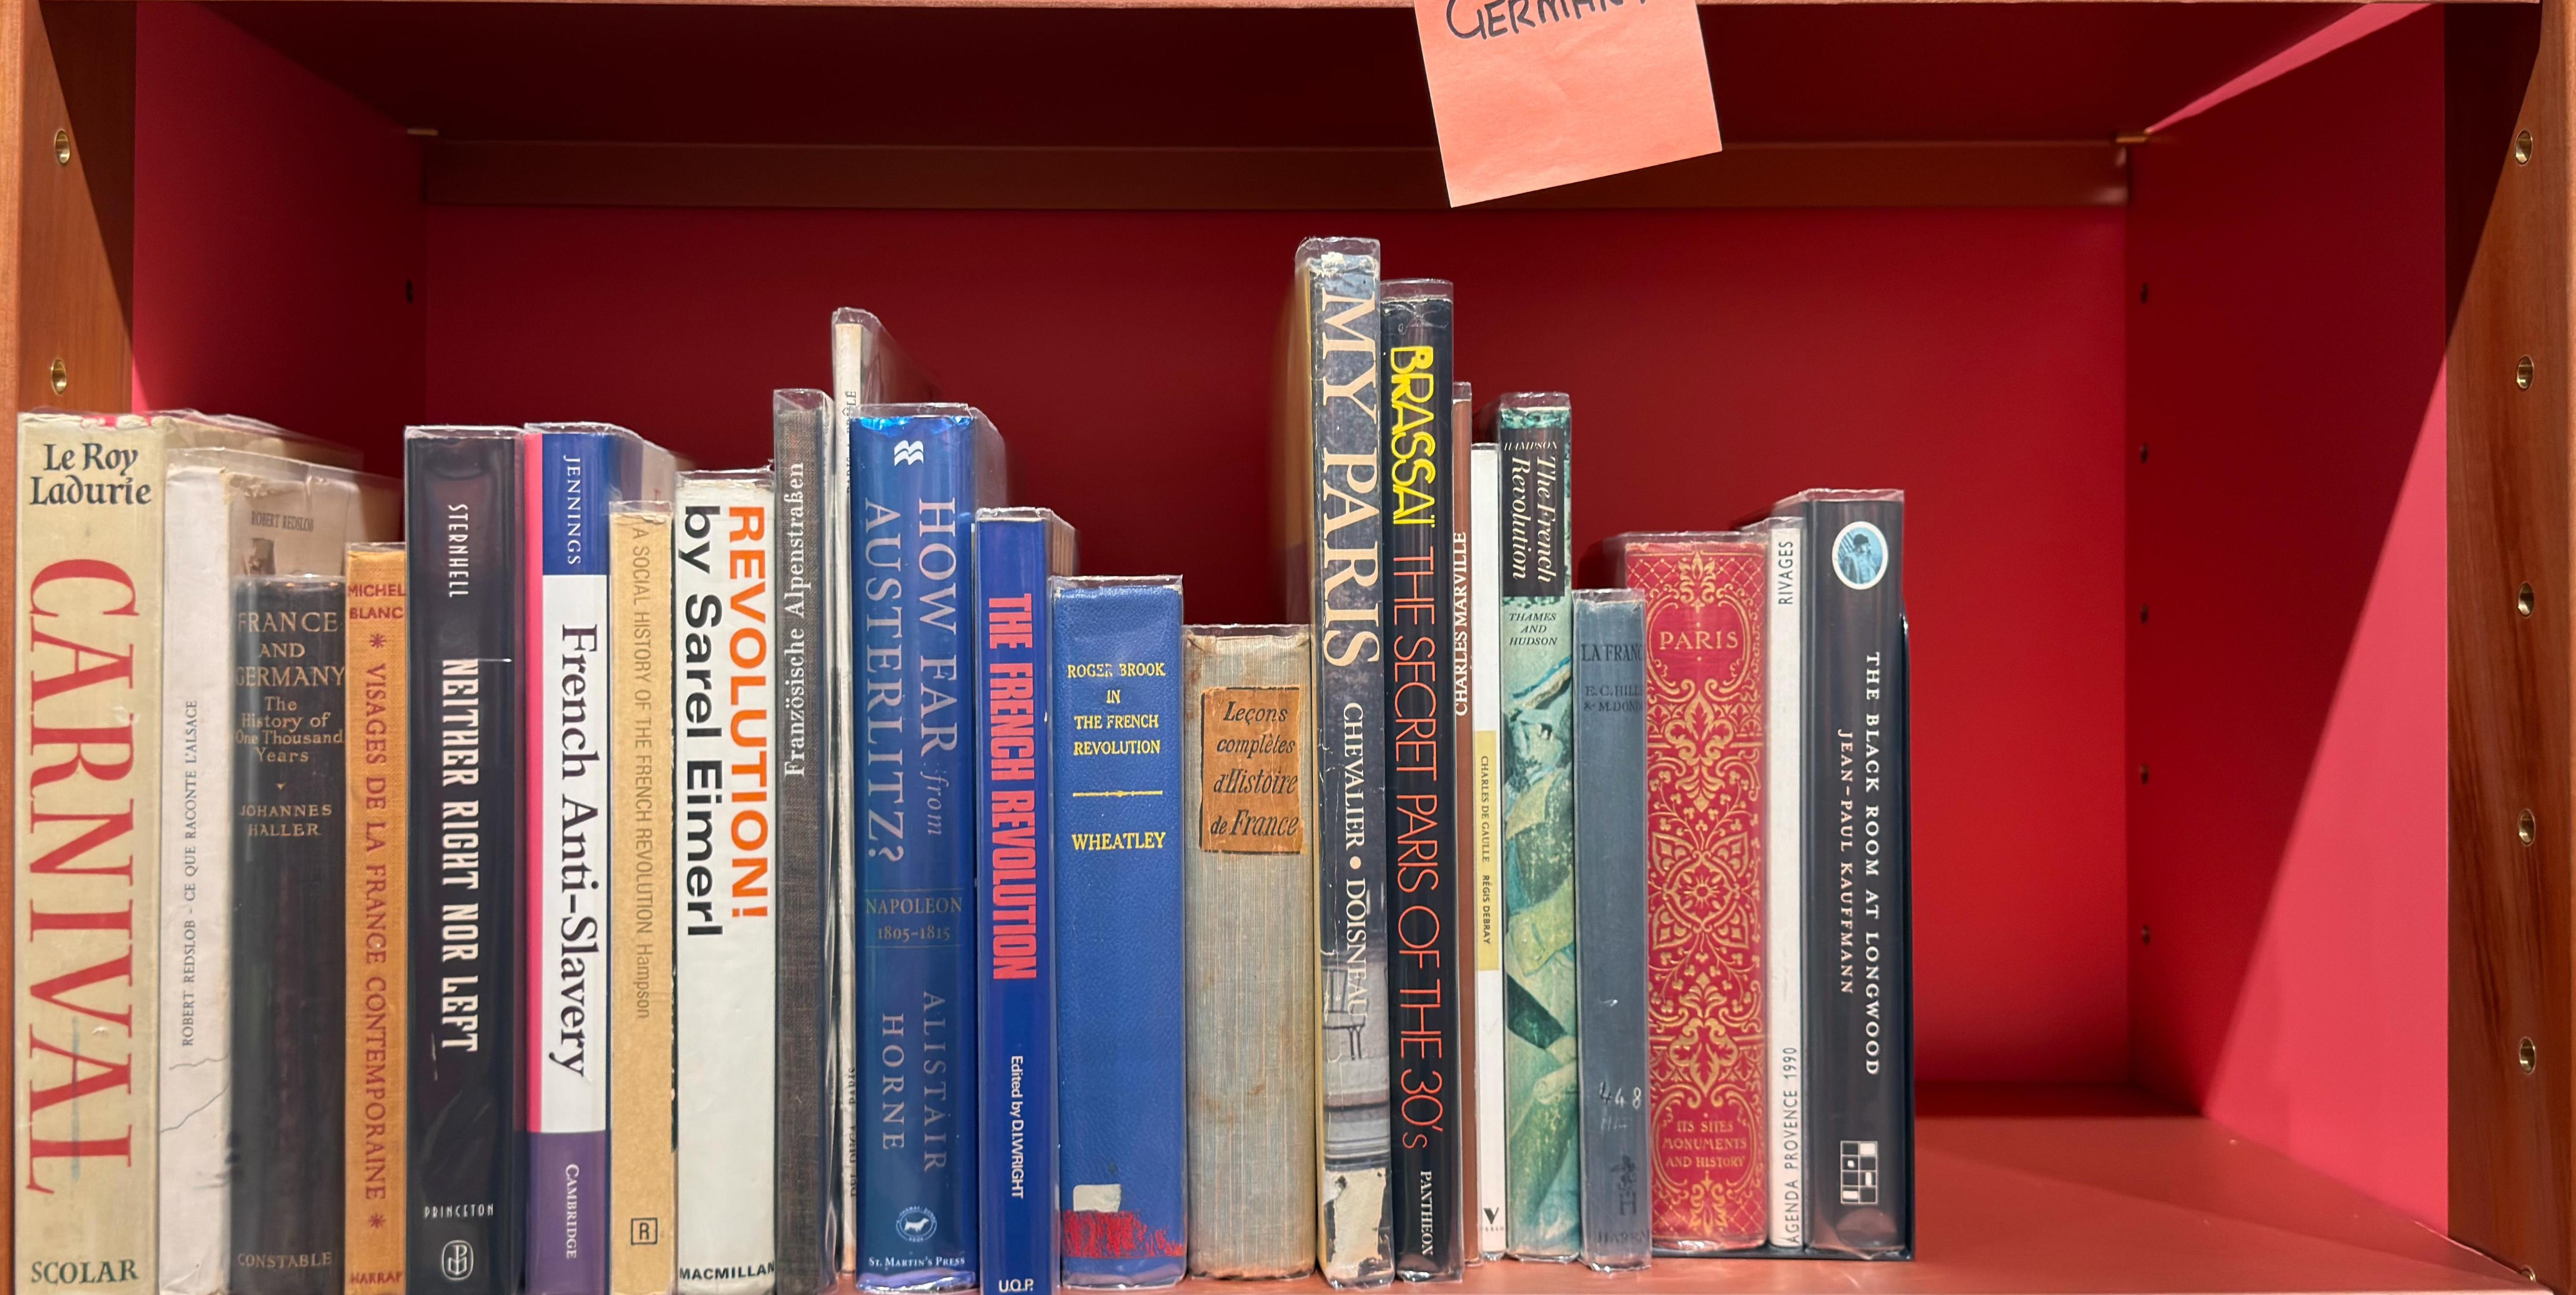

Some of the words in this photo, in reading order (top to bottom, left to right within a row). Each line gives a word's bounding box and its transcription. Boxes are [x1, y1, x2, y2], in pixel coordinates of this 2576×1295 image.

[1321, 287, 1376, 425] MY
[44, 443, 75, 470] Le
[83, 443, 138, 476] Roy
[1390, 346, 1435, 527] BRASSAÏ
[1504, 441, 1558, 450] HAMPSON
[30, 477, 151, 505] Ladurie
[1537, 456, 1556, 498] The
[564, 456, 581, 565] JENNINGS
[632, 529, 649, 539] A
[678, 506, 721, 575] by
[784, 463, 810, 618] Alpenstraßen
[1512, 456, 1532, 580] Revolution
[448, 503, 468, 598] STERNHELL
[918, 497, 957, 635] HOW
[1322, 446, 1379, 667] PARIS
[1537, 503, 1556, 582] French
[1778, 541, 1793, 605] RIVAGES
[348, 584, 406, 597] MICHEL
[633, 547, 650, 605] SOCIAL
[1394, 546, 1434, 624] THE
[1454, 532, 1467, 627] MARVILLE
[238, 612, 338, 633] FRANCE
[349, 607, 403, 620] BLANC
[989, 593, 1033, 649] THE
[1509, 613, 1556, 622] THAMES
[1509, 637, 1558, 646] HUDSON
[1659, 631, 1738, 650] PARIS
[235, 667, 345, 686] GERMANY
[260, 643, 305, 658] AND
[634, 612, 651, 682] HISTORY
[685, 595, 722, 737] Sarel
[1068, 664, 1112, 678] ROGER
[1120, 662, 1166, 677] BROOK
[1455, 631, 1467, 716] CHARLES
[1581, 644, 1600, 661] LA
[1866, 652, 1880, 700] THE
[265, 697, 296, 711] The
[561, 624, 600, 780] French
[635, 689, 651, 710] OF
[785, 629, 804, 777] Französische
[865, 497, 905, 862] AUSTERLITZ?
[920, 655, 958, 756] FAR
[1106, 689, 1121, 704] IN
[1394, 636, 1438, 781] SECRET
[185, 700, 197, 763] L'ALSACE
[235, 730, 258, 744] One
[263, 730, 343, 744] Thousand
[242, 712, 301, 731] History
[310, 712, 330, 726] of
[366, 664, 387, 765] VISAGES
[443, 659, 479, 786] NEITHER
[635, 719, 651, 748] THE
[728, 507, 769, 918] REVOLUTION!
[990, 663, 1034, 781] FRENCH
[1074, 715, 1102, 730] THE
[1106, 715, 1159, 728] FRENCH
[1223, 701, 1288, 725] Leçons
[255, 748, 308, 762] Years
[1074, 740, 1160, 755] REVOLUTION
[1217, 734, 1295, 759] complètes
[1344, 703, 1365, 850] CHEVALIER
[1866, 714, 1880, 792] BLACK
[185, 771, 196, 840] RACONTE
[240, 804, 332, 818] JOHANNES
[366, 777, 387, 810] DE
[636, 756, 652, 821] FRENCH
[921, 770, 949, 835] from
[1214, 768, 1298, 794] d'Histoire
[1482, 806, 1489, 818] DE
[1838, 730, 1854, 852] JEAN-PAUL
[248, 822, 320, 836] HALLER
[366, 819, 386, 852] LA
[443, 800, 479, 890] RIGHT
[687, 760, 723, 936] Eimerl
[1072, 832, 1166, 850] WHEATLEY
[1211, 816, 1228, 835] de
[1229, 810, 1299, 836] France
[1396, 794, 1439, 892] PARIS
[1866, 805, 1880, 876] ROOM
[26, 559, 139, 1195] CARNIVAL
[185, 846, 196, 877] QUE
[185, 882, 196, 901] CE
[636, 828, 653, 934] REVOLUTION
[992, 790, 1037, 980] REVOLUTION
[1483, 875, 1492, 902] RÉGIS
[366, 864, 387, 963] FRANCE
[442, 904, 479, 962] NOR
[865, 897, 962, 914] NAPOLEON
[878, 925, 950, 943] 1805-1815
[1840, 863, 1853, 994] KAUFFMANN
[1866, 889, 1880, 919] AT
[183, 920, 196, 986] REDSLOB
[549, 794, 600, 1077] Anti-Slavery
[1346, 878, 1367, 1025] DOISNEAU
[1398, 905, 1440, 969] OF
[636, 945, 653, 1018] Hampson
[1866, 932, 1880, 1075] LONGWOOD
[182, 991, 194, 1047] ROBERT
[442, 975, 479, 1052] LEFT
[1399, 979, 1442, 1058] THE
[364, 976, 387, 1200] CONTEMPORAINE
[882, 1014, 904, 1149] HORNE
[924, 991, 947, 1172] ALISTAIR
[1012, 1056, 1023, 1098] Edited
[1783, 1047, 1797, 1081] 1990
[1010, 1102, 1023, 1117] by
[1677, 1121, 1694, 1132] ITS
[1701, 1121, 1733, 1132] SITES
[1785, 1090, 1799, 1170] PROVENCE
[1662, 1138, 1746, 1150] MONUMENTS
[1666, 1156, 1692, 1167] AND
[1696, 1156, 1745, 1167] HISTORY
[424, 1204, 493, 1218] PRINCETON
[565, 1164, 580, 1259] CAMBRIDGE
[1420, 1171, 1433, 1256] PANTHEON
[1786, 1181, 1800, 1243] AGENDA
[32, 1259, 138, 1284] SCOLAR
[238, 1252, 332, 1269] CONSTABLE
[680, 1261, 775, 1279] MACMILLAN
